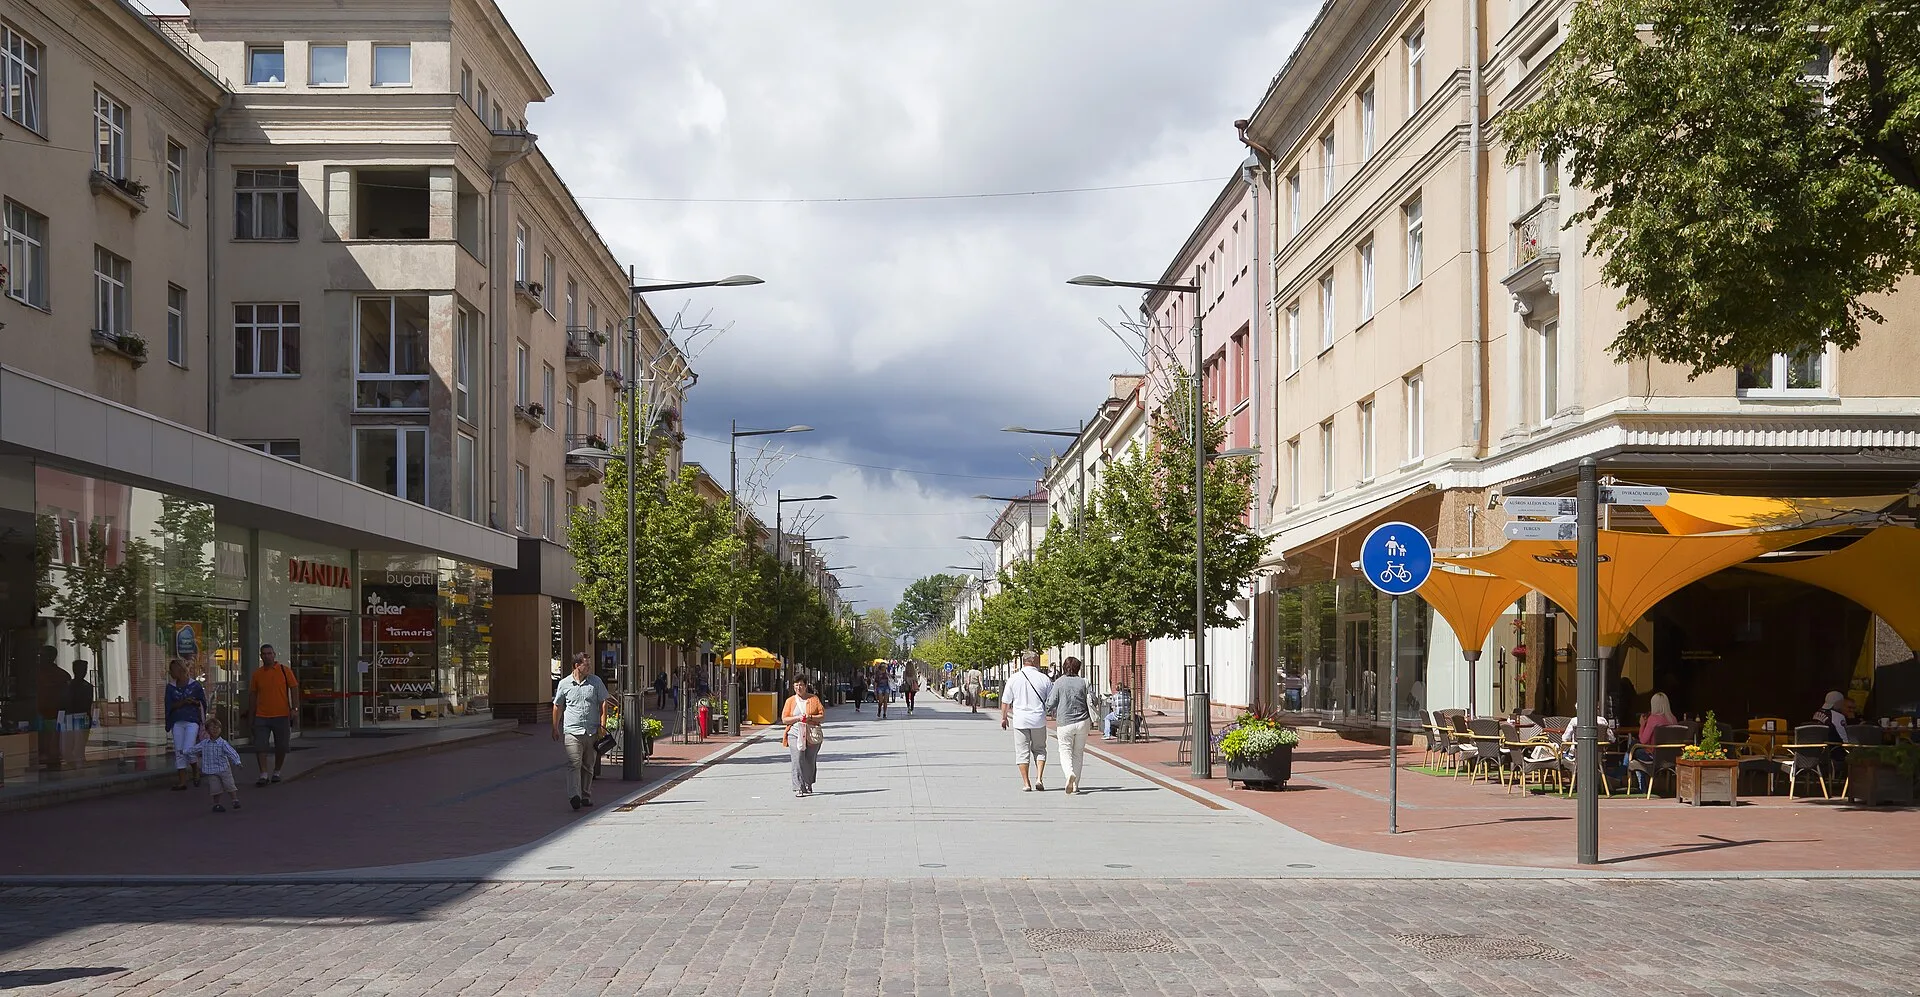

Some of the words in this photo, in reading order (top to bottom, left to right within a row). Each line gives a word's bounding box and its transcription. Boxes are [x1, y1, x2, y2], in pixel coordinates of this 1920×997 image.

[289, 558, 351, 589] DANIJA
[386, 571, 434, 588] bugatti
[367, 601, 406, 615] rieker
[386, 626, 434, 637] tamaris
[390, 682, 434, 693] WAWA
